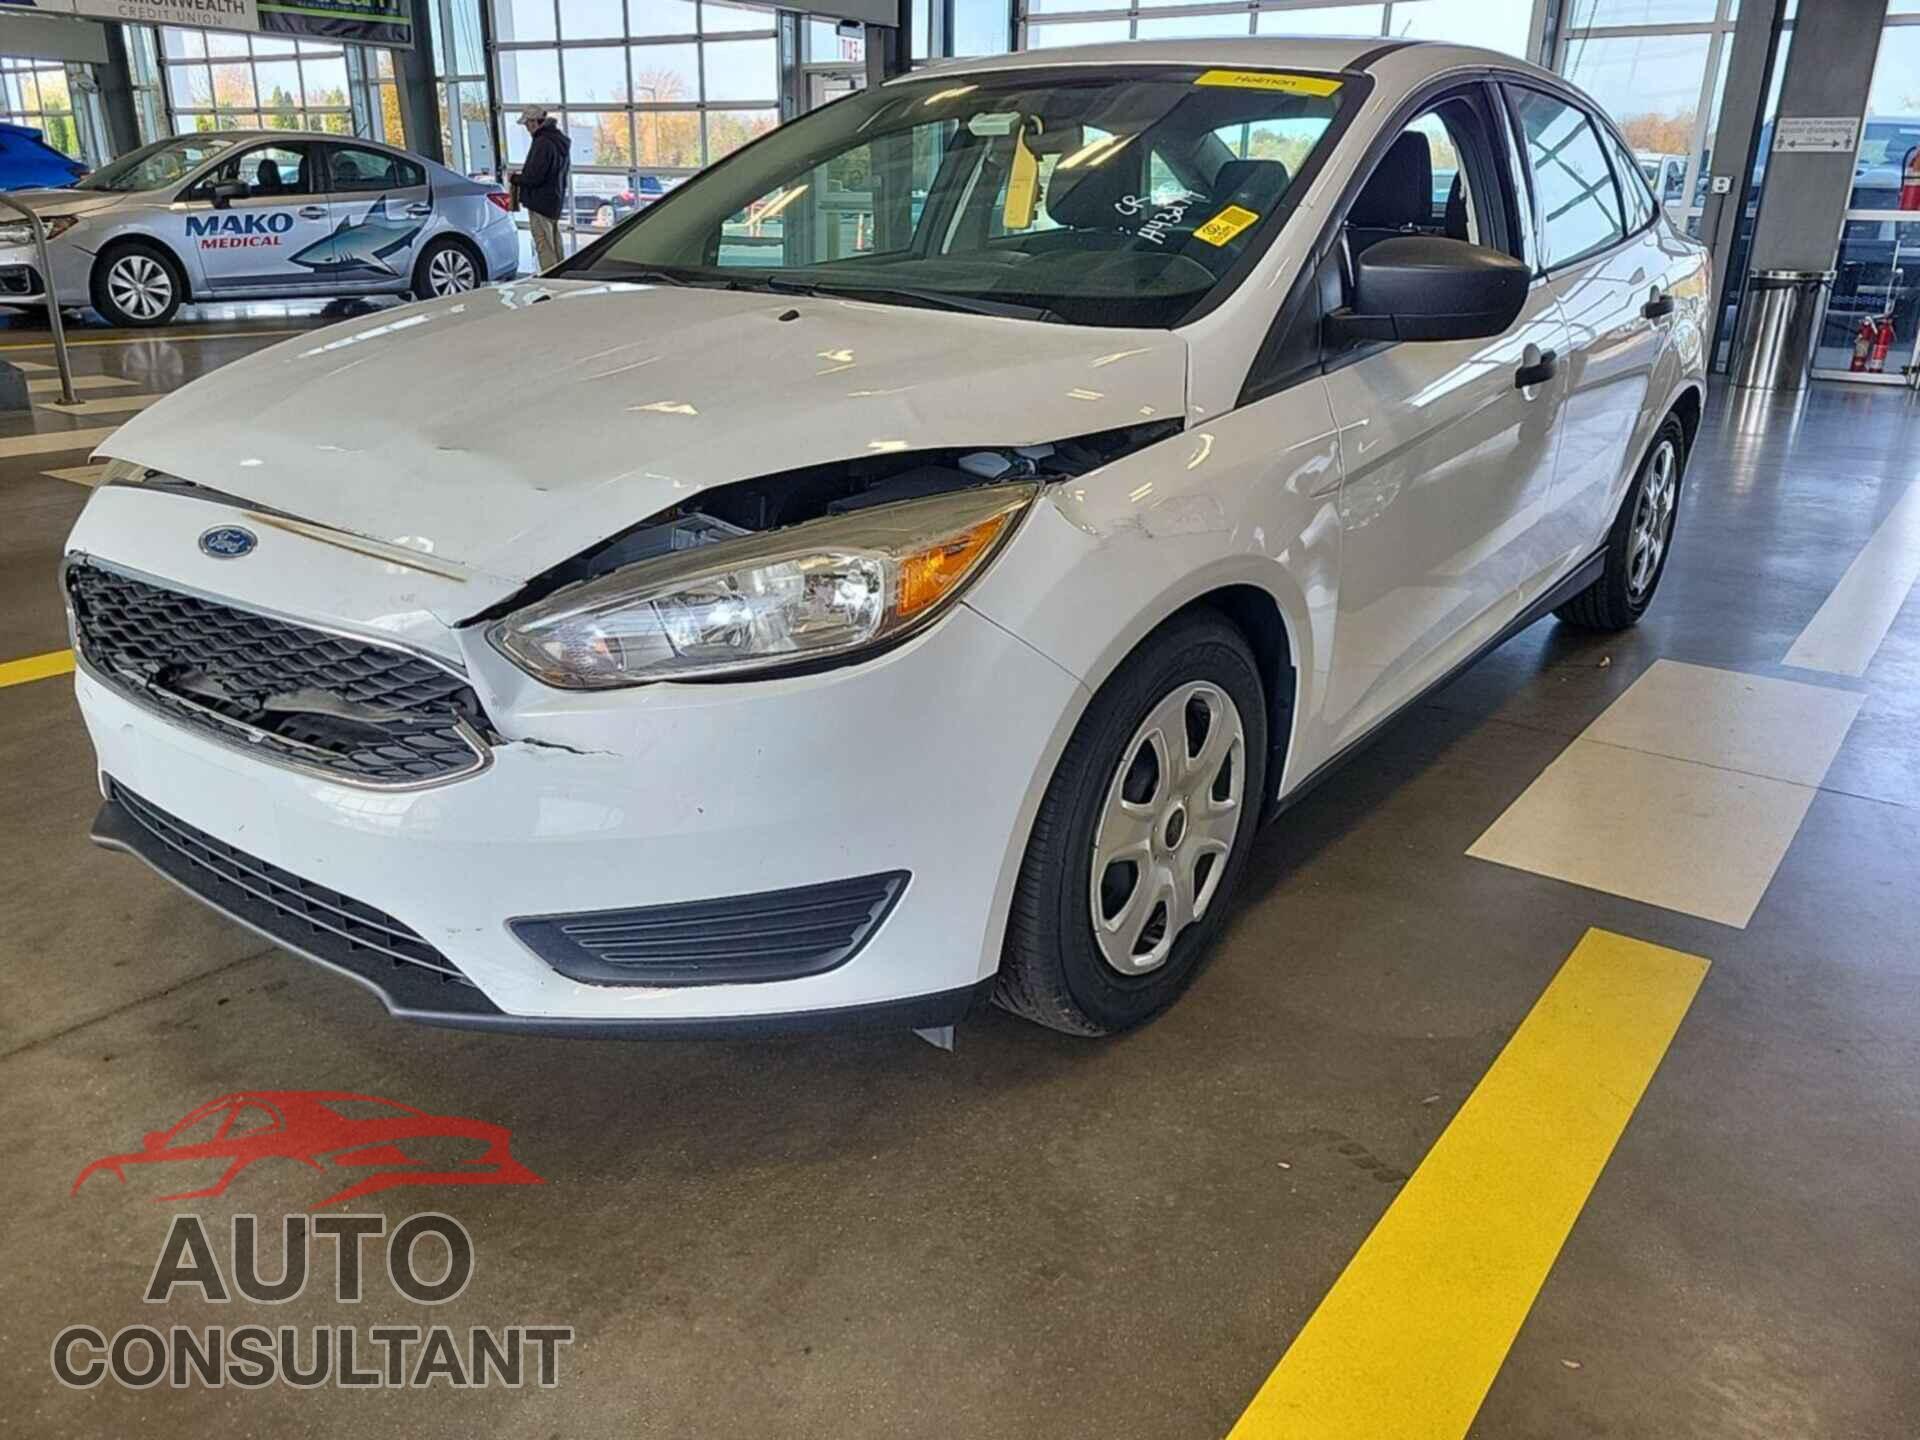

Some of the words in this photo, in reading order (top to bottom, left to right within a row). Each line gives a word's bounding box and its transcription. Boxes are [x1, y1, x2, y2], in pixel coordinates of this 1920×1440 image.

[118, 5, 169, 20] CREDIT
[176, 10, 223, 25] UNION
[185, 212, 294, 237] MAKO
[201, 235, 283, 249] MEDICAL
[208, 531, 247, 553] Ford
